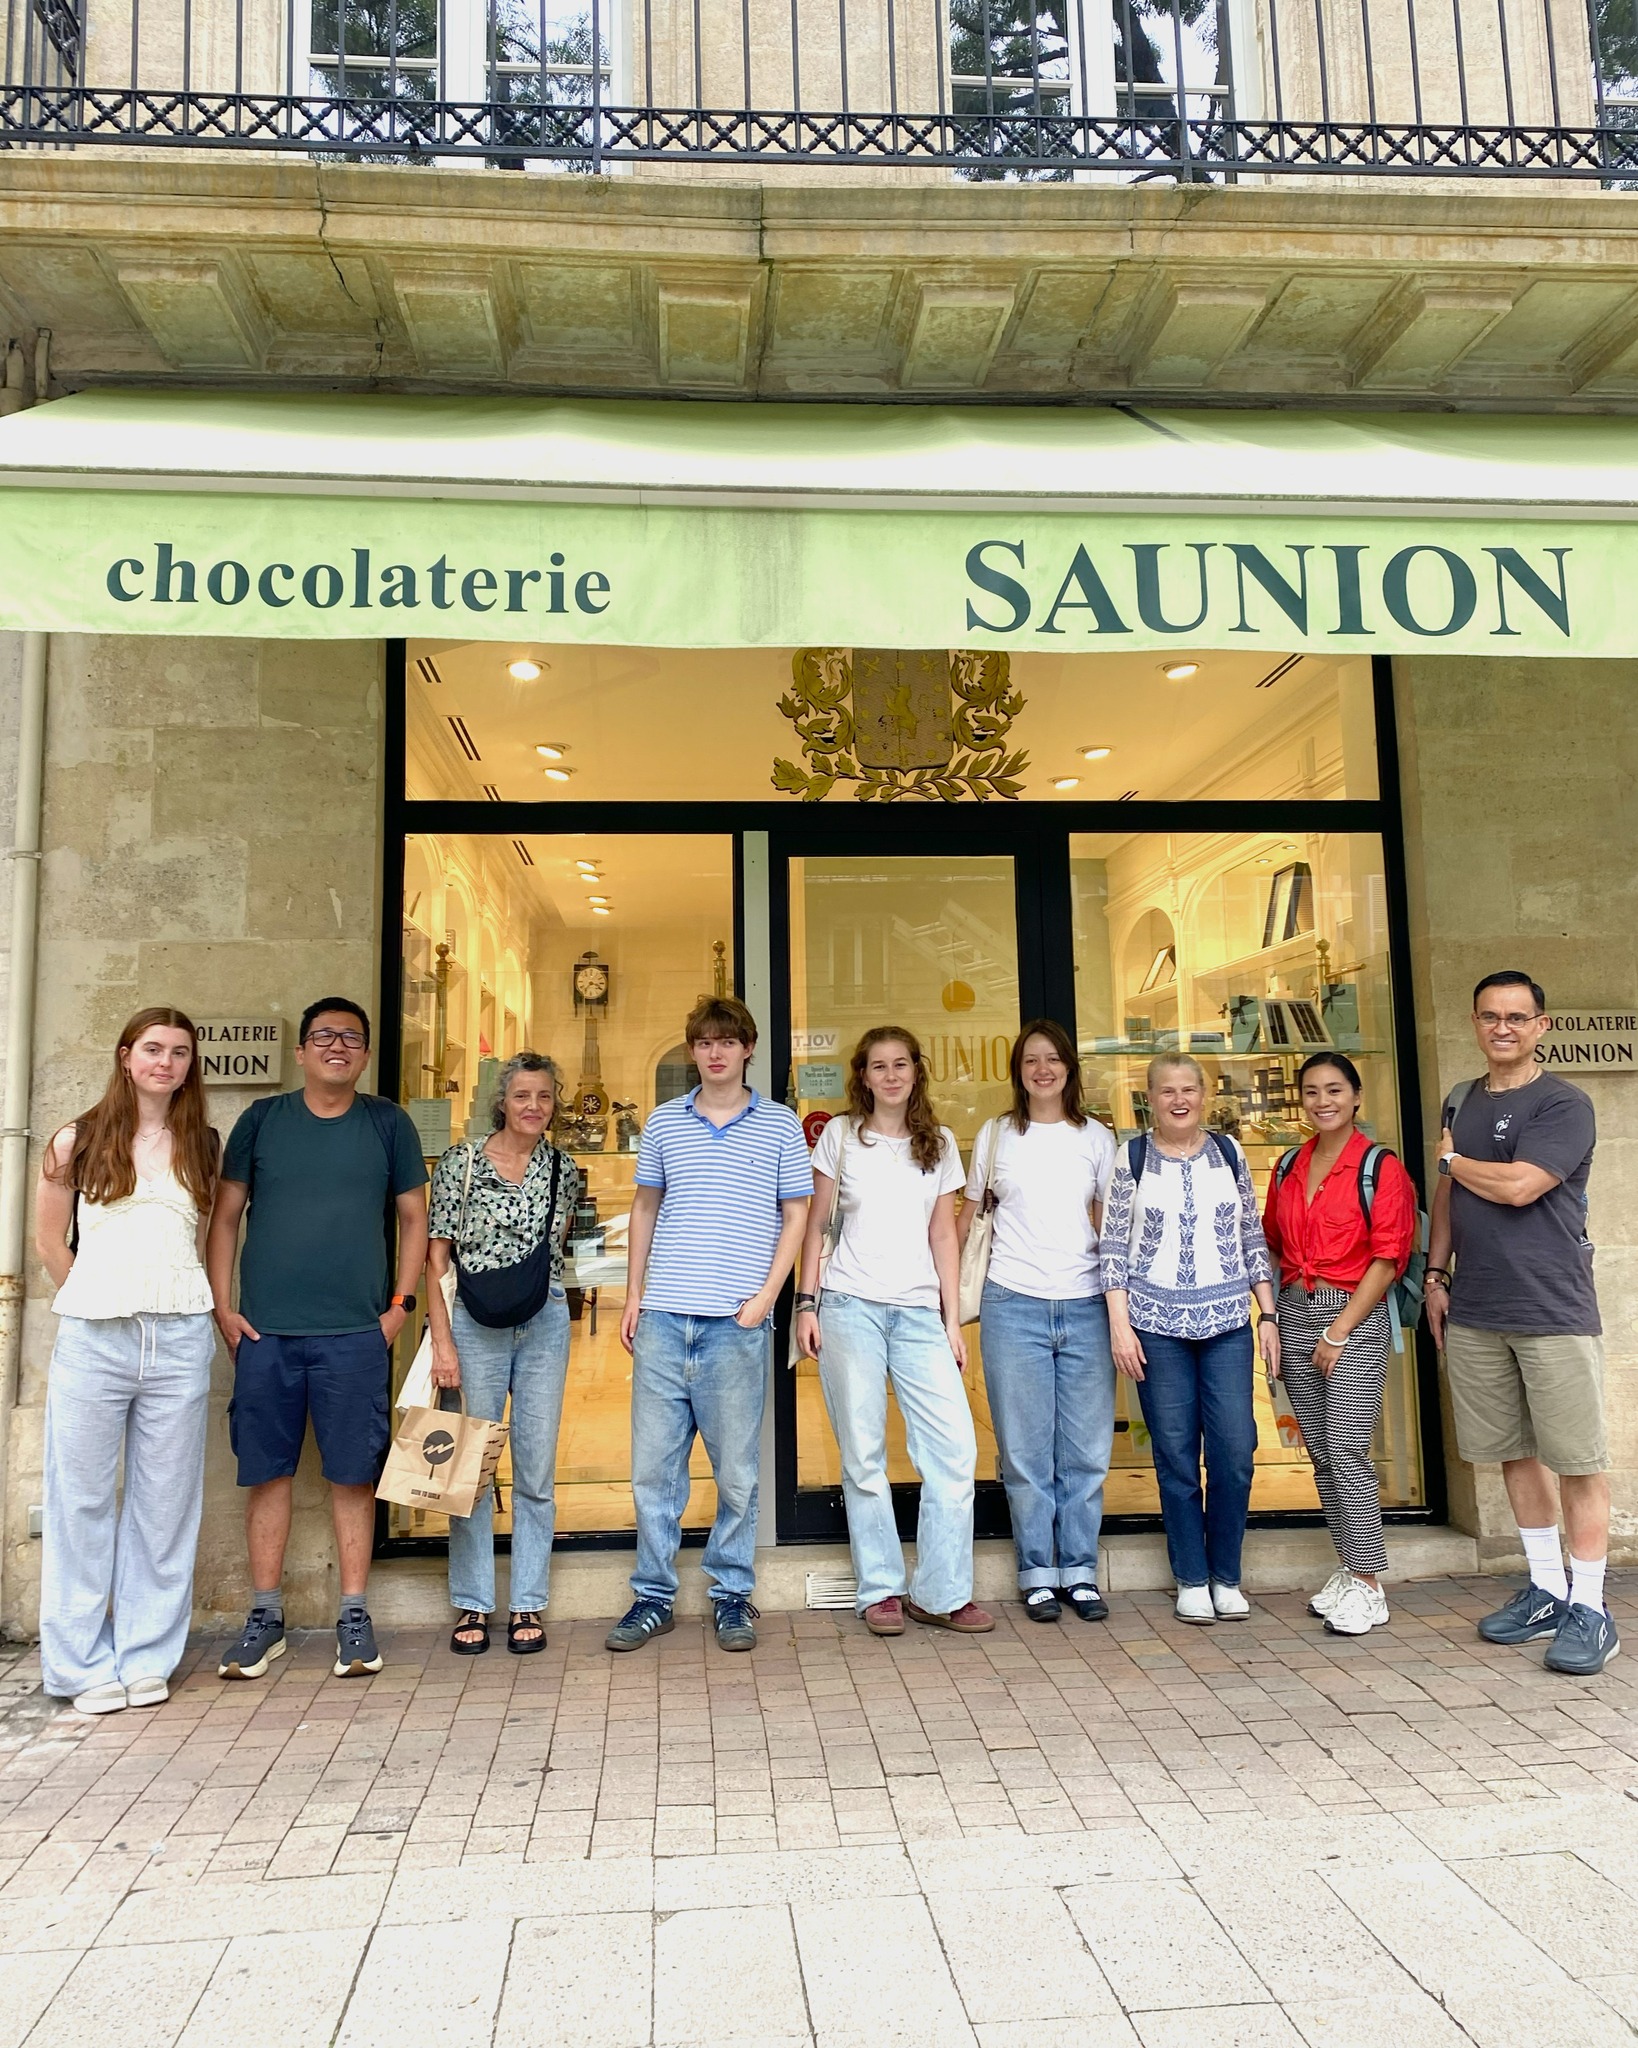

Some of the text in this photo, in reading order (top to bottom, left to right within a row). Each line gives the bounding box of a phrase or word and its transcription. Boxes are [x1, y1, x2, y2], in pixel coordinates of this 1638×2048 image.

[106, 542, 611, 615] chocolaterie
[966, 539, 1573, 637] SAUNION
[199, 1055, 269, 1076] NION
[929, 1035, 1018, 1082] UNIO
[1534, 1043, 1633, 1064] SAUNION
